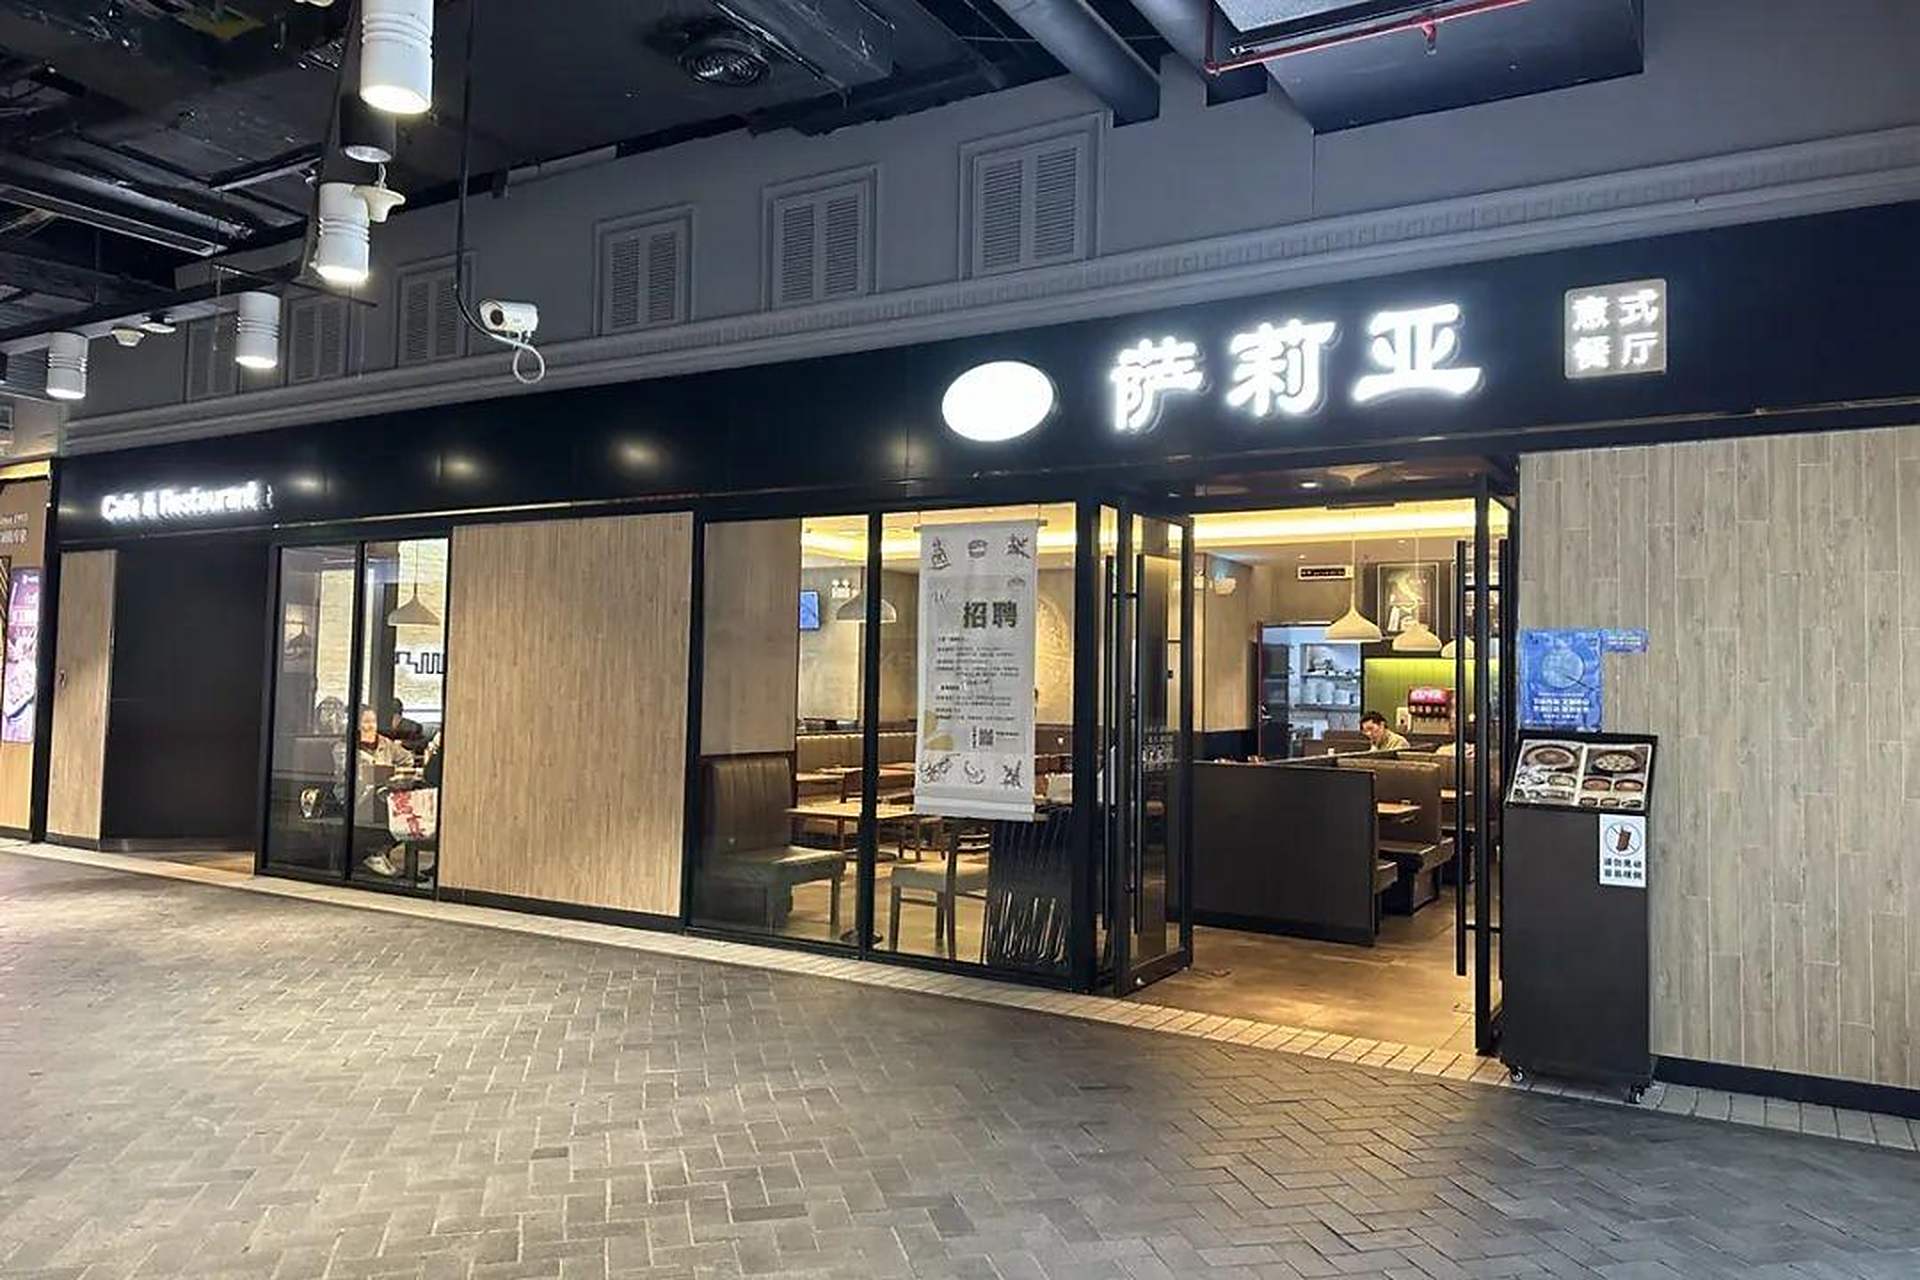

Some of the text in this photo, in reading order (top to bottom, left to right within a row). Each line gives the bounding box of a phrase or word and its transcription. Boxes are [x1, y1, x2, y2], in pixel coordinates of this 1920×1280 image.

[1110, 303, 1482, 431] 萨莉亚
[1572, 332, 1659, 370] 餐厅
[963, 601, 1017, 628] 招聘
